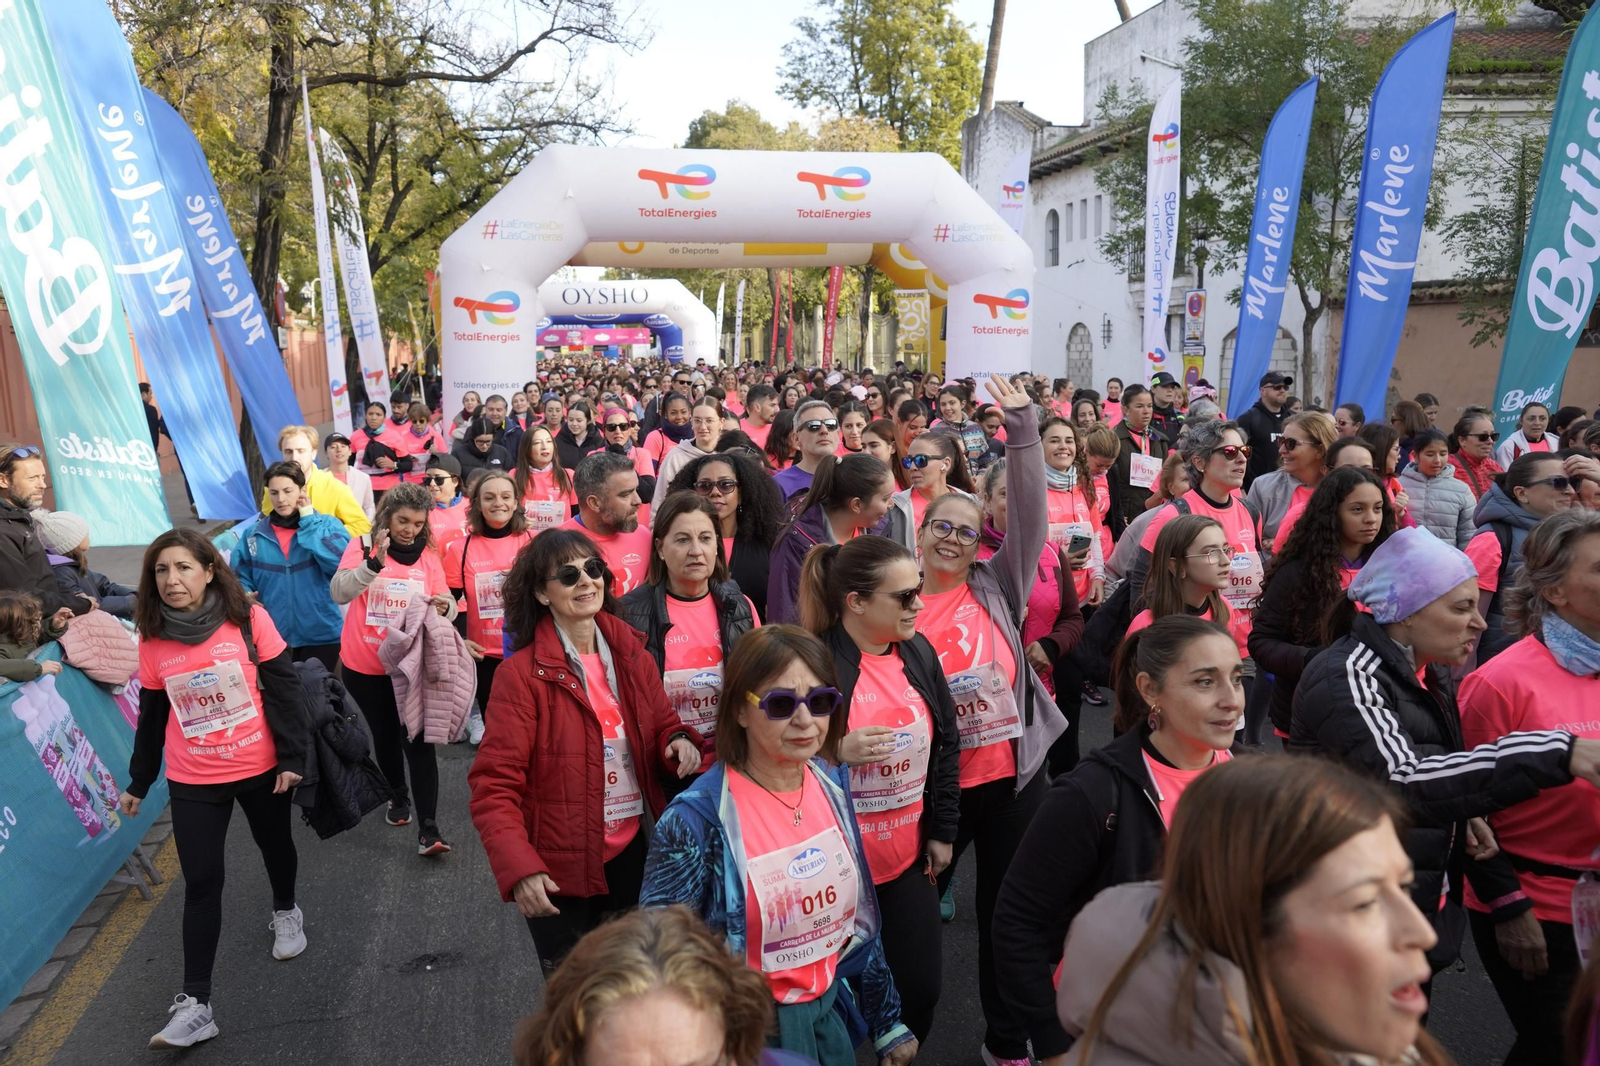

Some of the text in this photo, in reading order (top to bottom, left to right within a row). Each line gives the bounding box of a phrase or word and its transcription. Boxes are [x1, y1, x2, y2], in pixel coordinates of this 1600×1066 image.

[638, 208, 717, 219] TotalEnergies
[796, 209, 871, 220] TotalEnergies
[1357, 144, 1417, 303] Marlene
[682, 246, 719, 255] Deportes
[1245, 186, 1289, 320] Marlene
[562, 287, 648, 305] OYSHO
[972, 326, 1029, 337] TotalEnergies
[453, 332, 520, 343] TotalEnergies
[453, 381, 520, 390] totalenergies.es
[1142, 468, 1154, 476] 016
[537, 515, 553, 523] 016
[1231, 576, 1253, 586] 016
[386, 599, 407, 608] 016
[212, 646, 239, 654] ASTURIANA
[190, 676, 218, 688] ASTURIANA
[198, 692, 226, 707] 016
[692, 694, 718, 709] 016
[956, 699, 988, 717] 016
[190, 723, 213, 733] OYSHO
[967, 718, 983, 727] 1199
[986, 729, 1013, 740] Santander
[188, 731, 263, 755] ARRERA DE LA MUJER
[880, 758, 911, 777] 016
[860, 790, 881, 798] CARRERA
[856, 799, 887, 808] OYSHO
[613, 805, 637, 815] Santander
[877, 822, 888, 832] DE
[890, 819, 899, 829] LA
[877, 831, 893, 842] 2025
[792, 856, 827, 877] ASTURIANA
[763, 873, 787, 887] SUMA
[802, 885, 837, 916] 016
[813, 915, 831, 929] 5698
[780, 925, 836, 948] CARRERA DE LA MUJER
[776, 947, 814, 964] OYSHO
